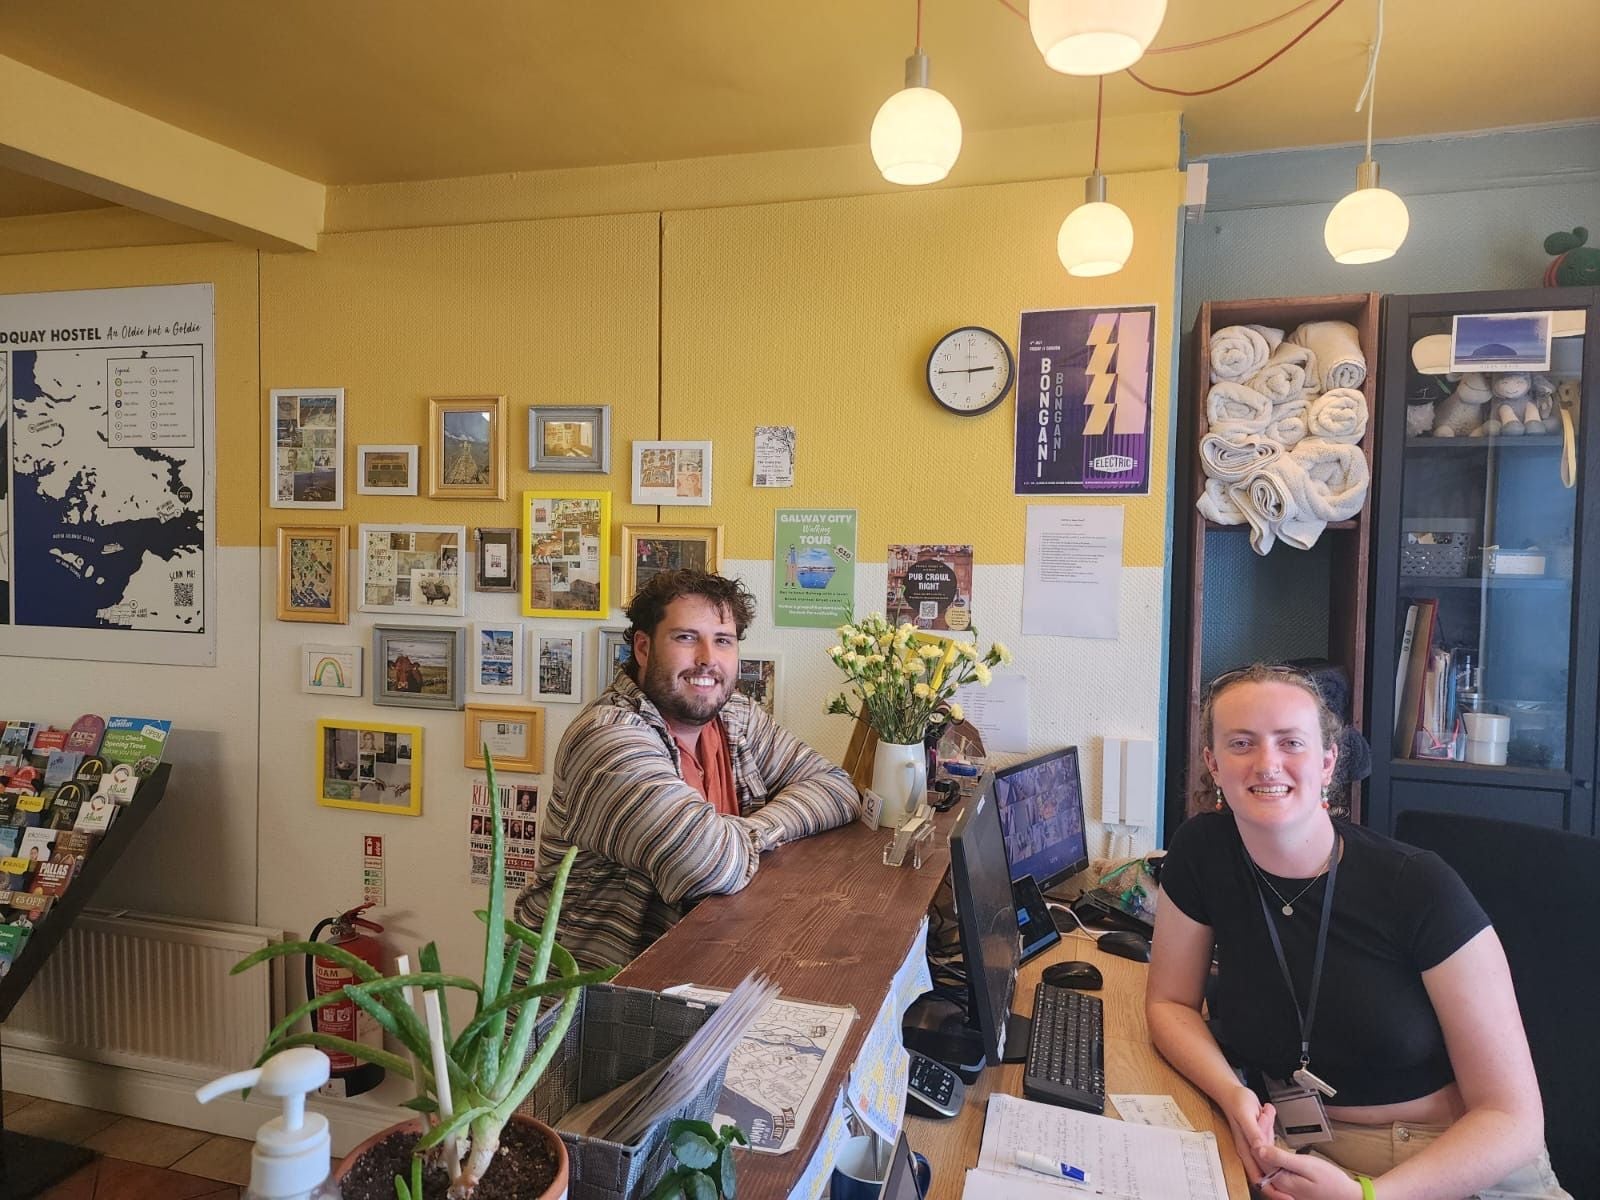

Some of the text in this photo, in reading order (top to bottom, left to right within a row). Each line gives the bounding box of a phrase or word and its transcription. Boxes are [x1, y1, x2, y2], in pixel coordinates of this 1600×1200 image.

[0, 328, 101, 344] DQUAY HOSTEL
[106, 321, 201, 340] An Oldie but a Goldie
[1037, 357, 1051, 478] BONGANI
[1053, 372, 1064, 462] BONGANI
[1095, 457, 1131, 468] ELECTRIC
[780, 515, 852, 523] GALWAY CITY
[802, 524, 831, 536] Walking
[799, 536, 832, 545] TOUR
[908, 573, 951, 581] PUB CRAWL
[918, 582, 940, 591] NIGHT
[145, 728, 162, 739] OPEN
[104, 741, 129, 749] Opening
[508, 846, 520, 854] JUL
[39, 862, 69, 876] PALLAS
[15, 895, 26, 904] €5
